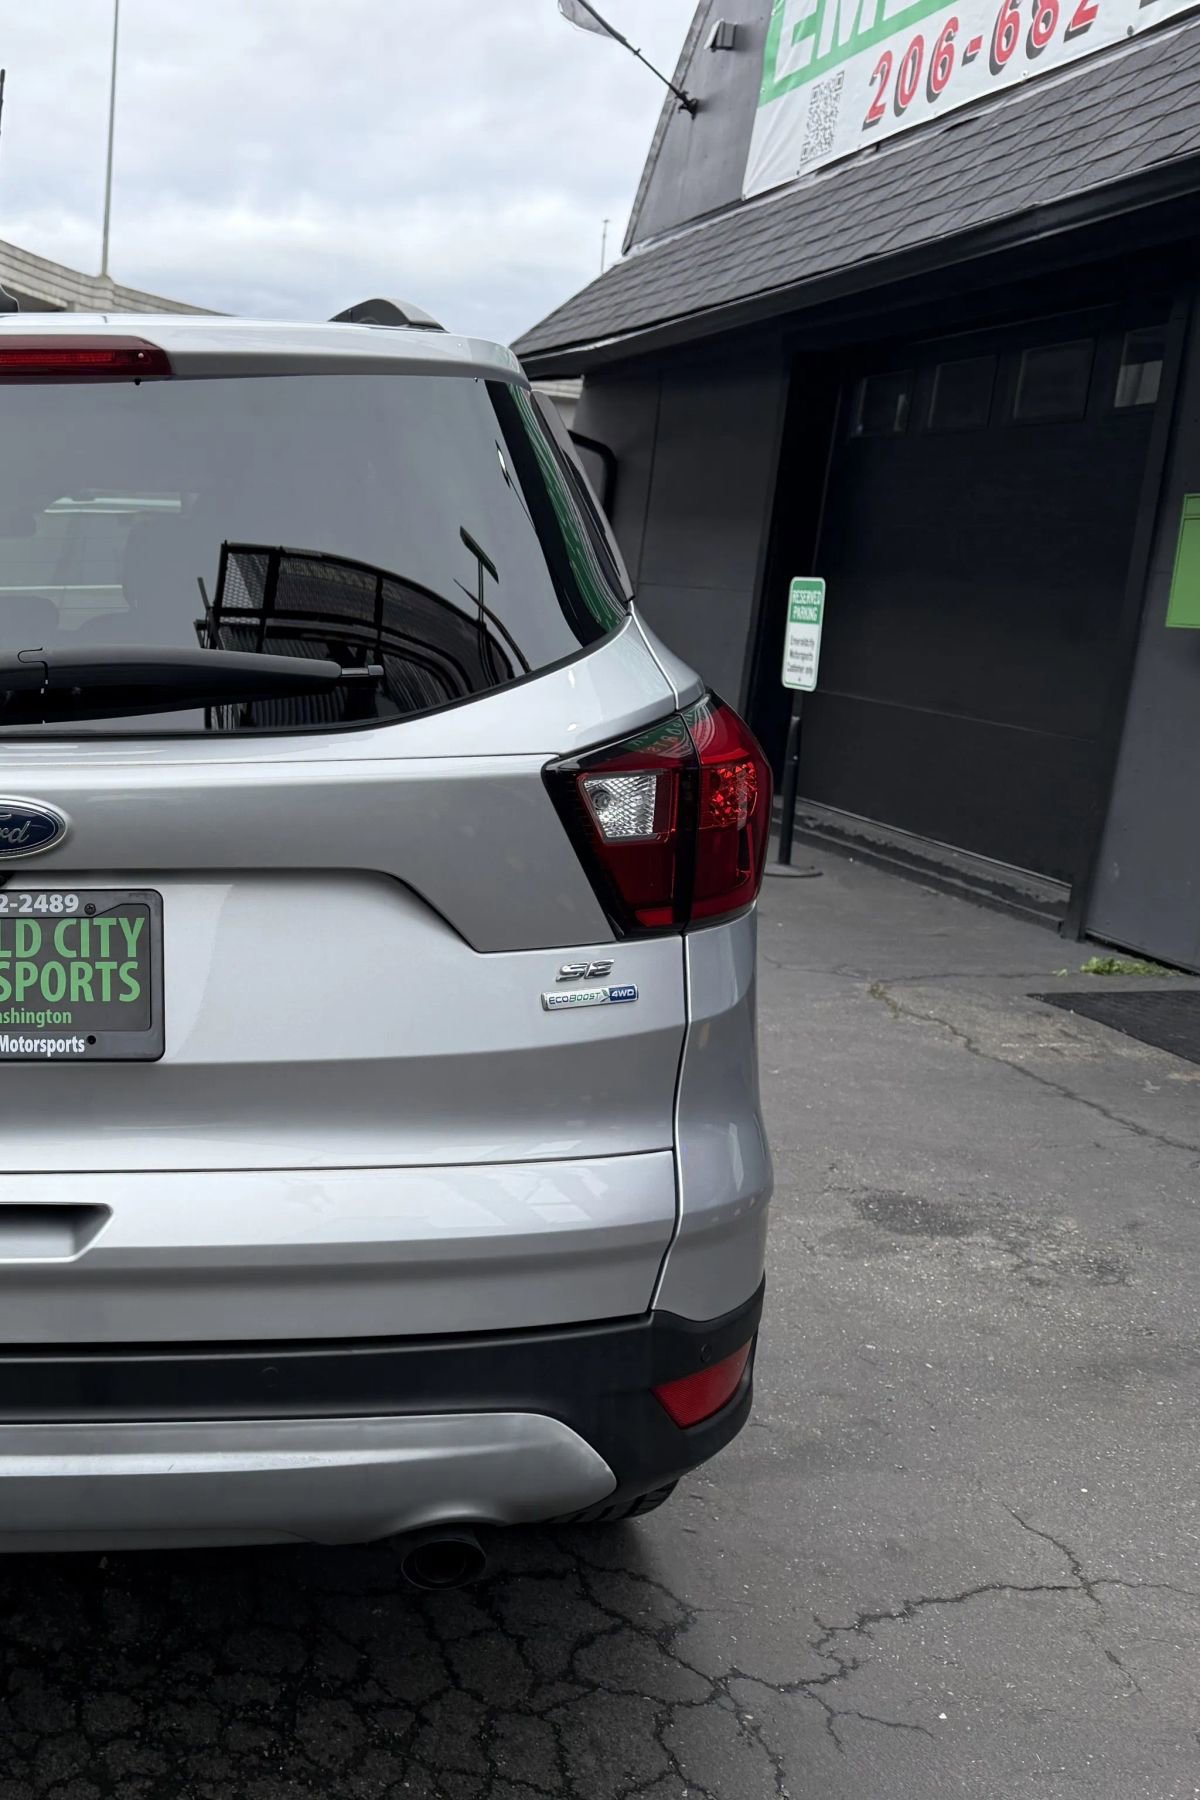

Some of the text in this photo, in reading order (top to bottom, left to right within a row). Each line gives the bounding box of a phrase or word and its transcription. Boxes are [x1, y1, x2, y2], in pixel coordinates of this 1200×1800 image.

[791, 590, 821, 605] RESERVED
[792, 605, 818, 621] PARKING
[53, 917, 145, 958] CITY
[555, 959, 615, 982] SE
[548, 988, 635, 1005] ECOBOOST 4WD
[0, 1034, 85, 1058] Motorsports
